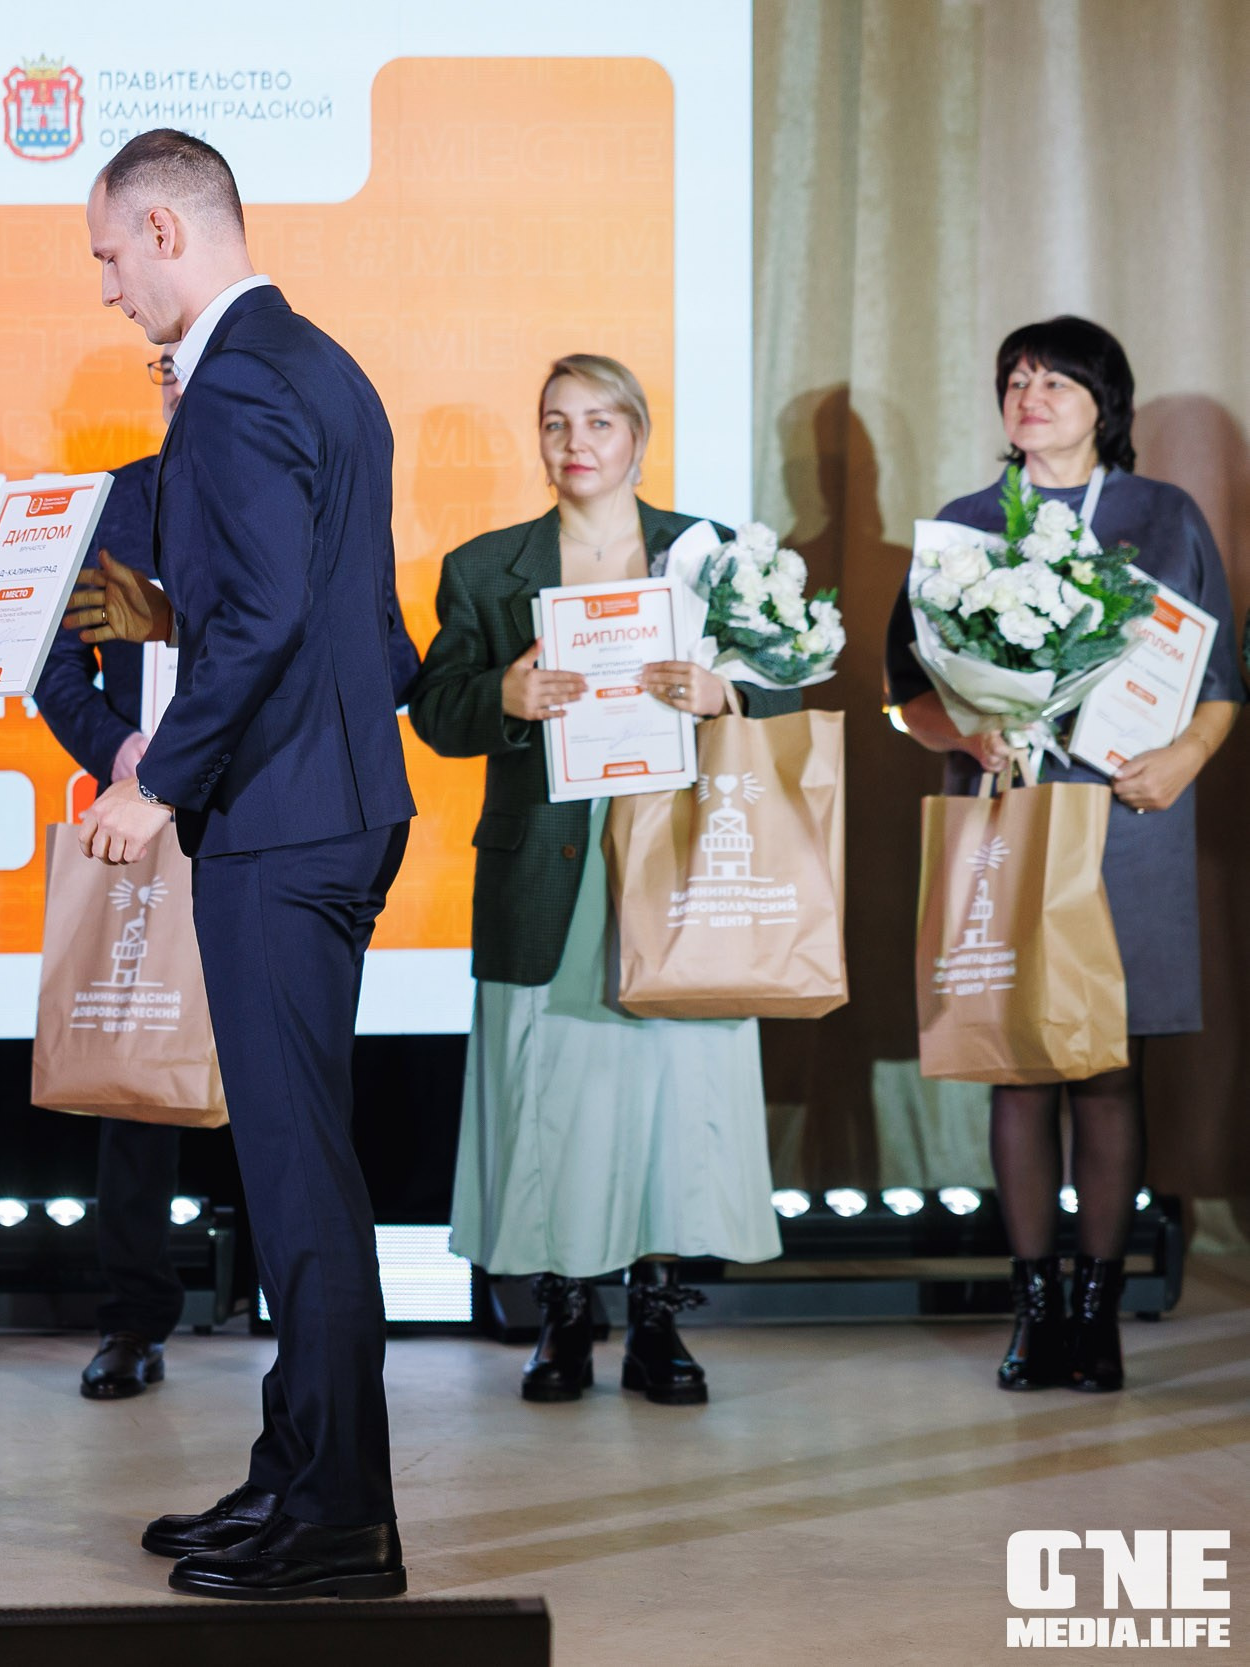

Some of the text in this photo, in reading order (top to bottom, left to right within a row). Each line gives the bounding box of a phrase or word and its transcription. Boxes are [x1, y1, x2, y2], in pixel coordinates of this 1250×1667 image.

[99, 71, 292, 91] ПРАВИТЕЛЬСТВО
[99, 95, 333, 120] КАЛИНИНГРАДСКОЙ
[2, 525, 72, 547] ДИПЛОМ
[6, 589, 29, 598] МЕСТО
[572, 626, 659, 648] ДИПЛОМ
